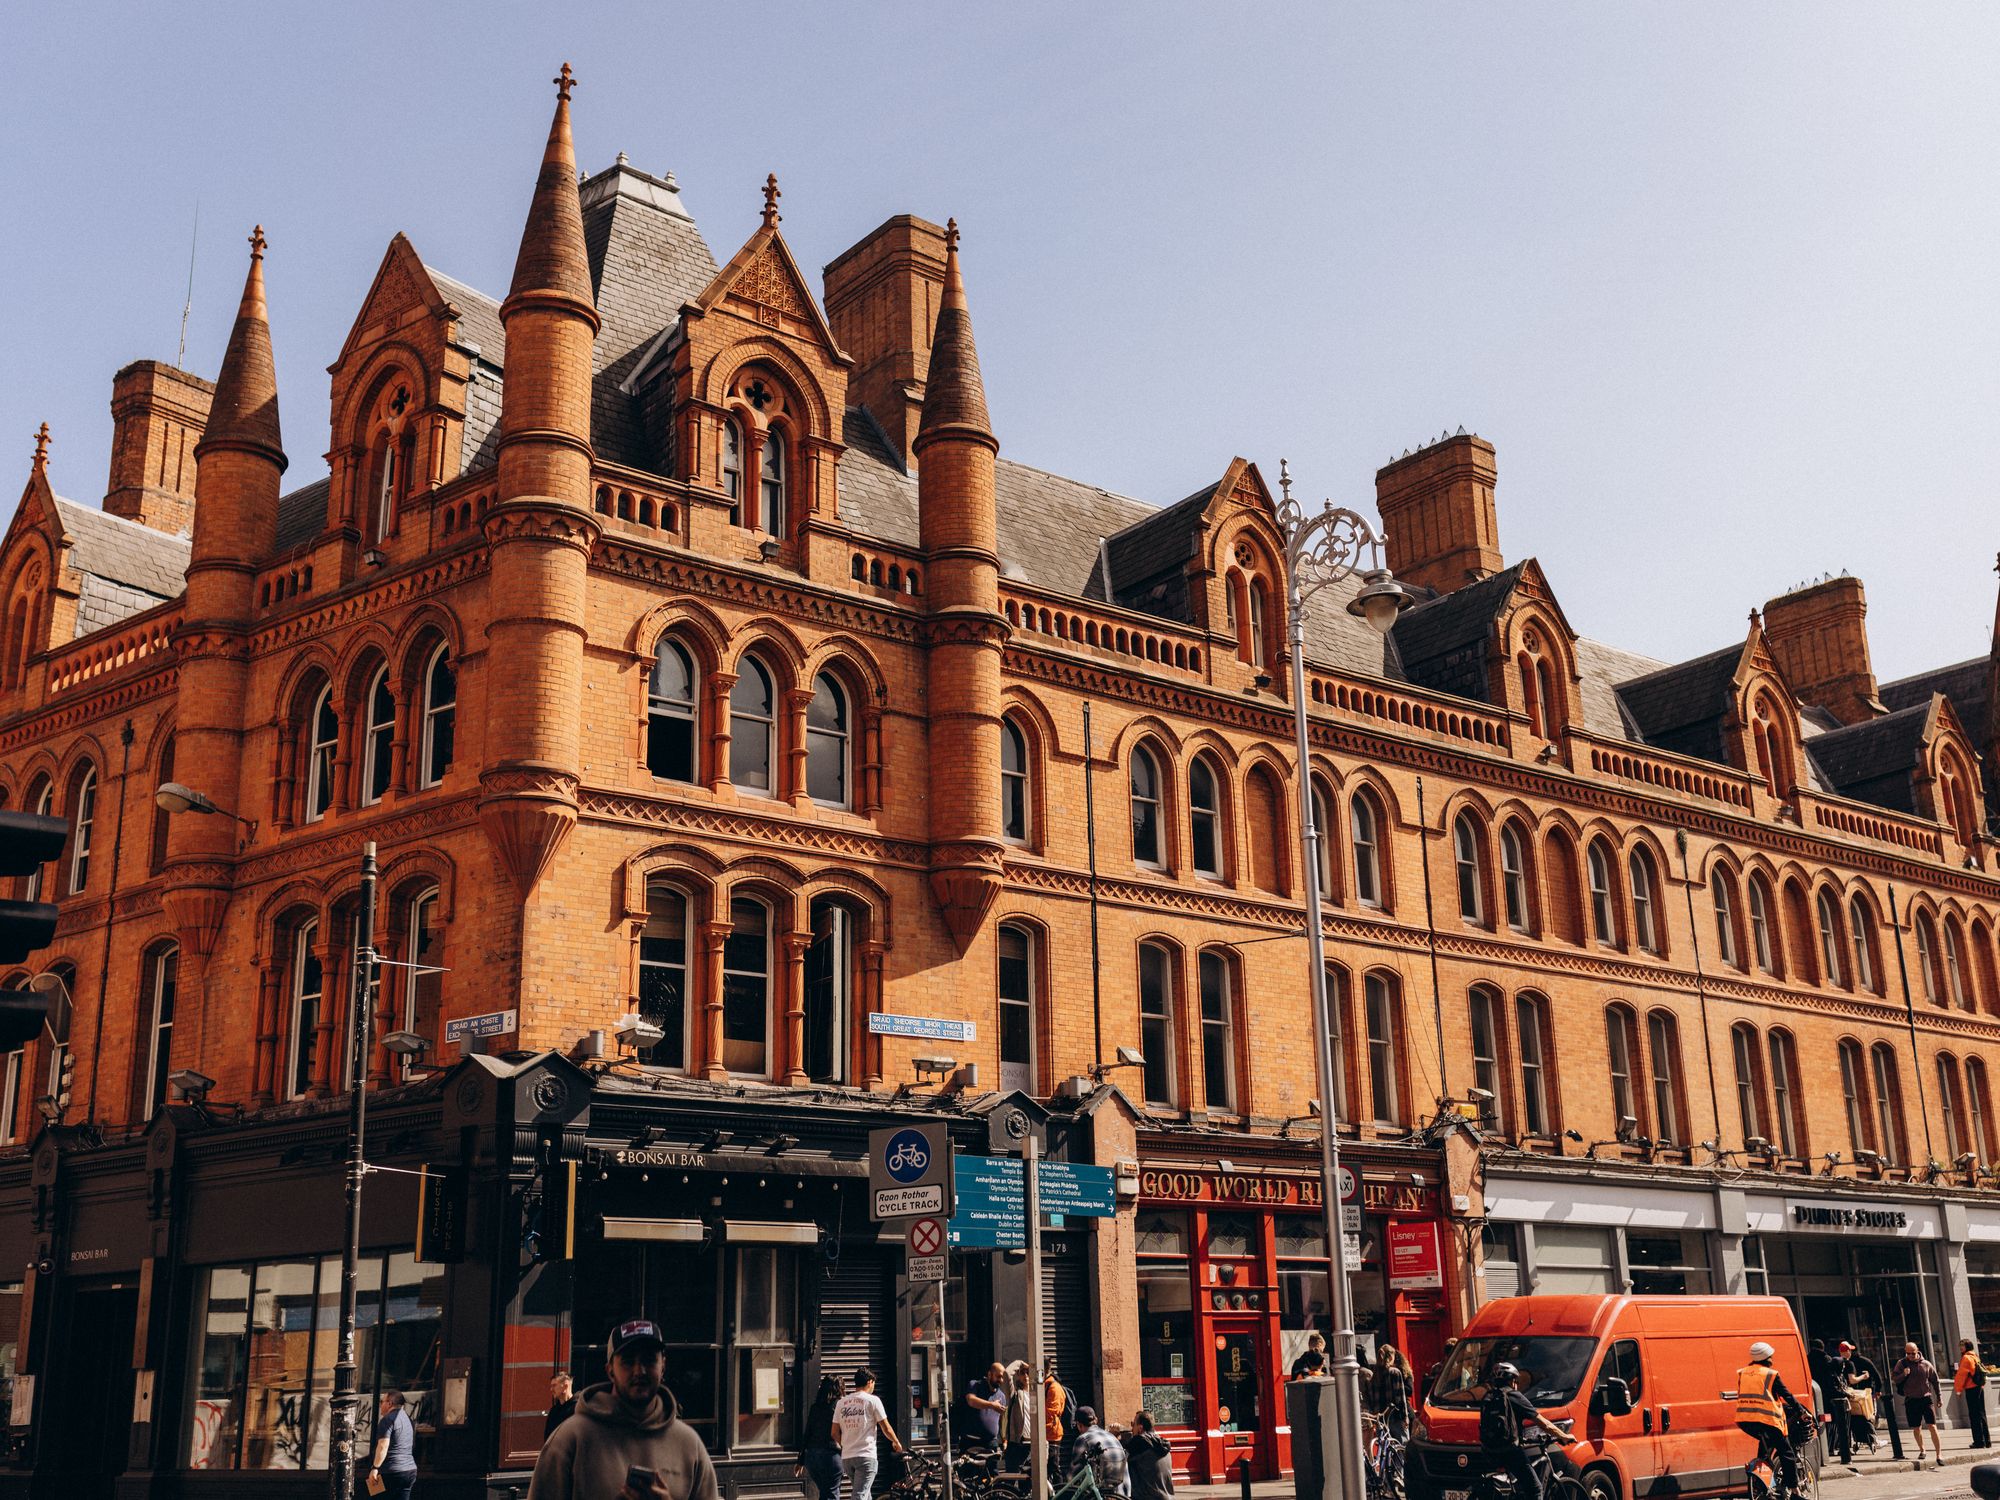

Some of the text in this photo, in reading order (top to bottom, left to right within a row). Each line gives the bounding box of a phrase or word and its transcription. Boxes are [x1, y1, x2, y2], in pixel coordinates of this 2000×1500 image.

[481, 1016, 499, 1024] CHISTE
[507, 1017, 512, 1026] 2
[482, 1024, 502, 1033] STREET
[967, 1027, 972, 1036] 2
[628, 1152, 705, 1166] BONSAI BAR
[1142, 1171, 1202, 1196] GOOD
[1213, 1176, 1292, 1200] WORLD
[879, 1190, 929, 1202] Raon Rothar
[879, 1200, 939, 1213] CYCLE TRACK
[1392, 1232, 1415, 1240] Lisney
[72, 1249, 108, 1261] BONSAI BAR
